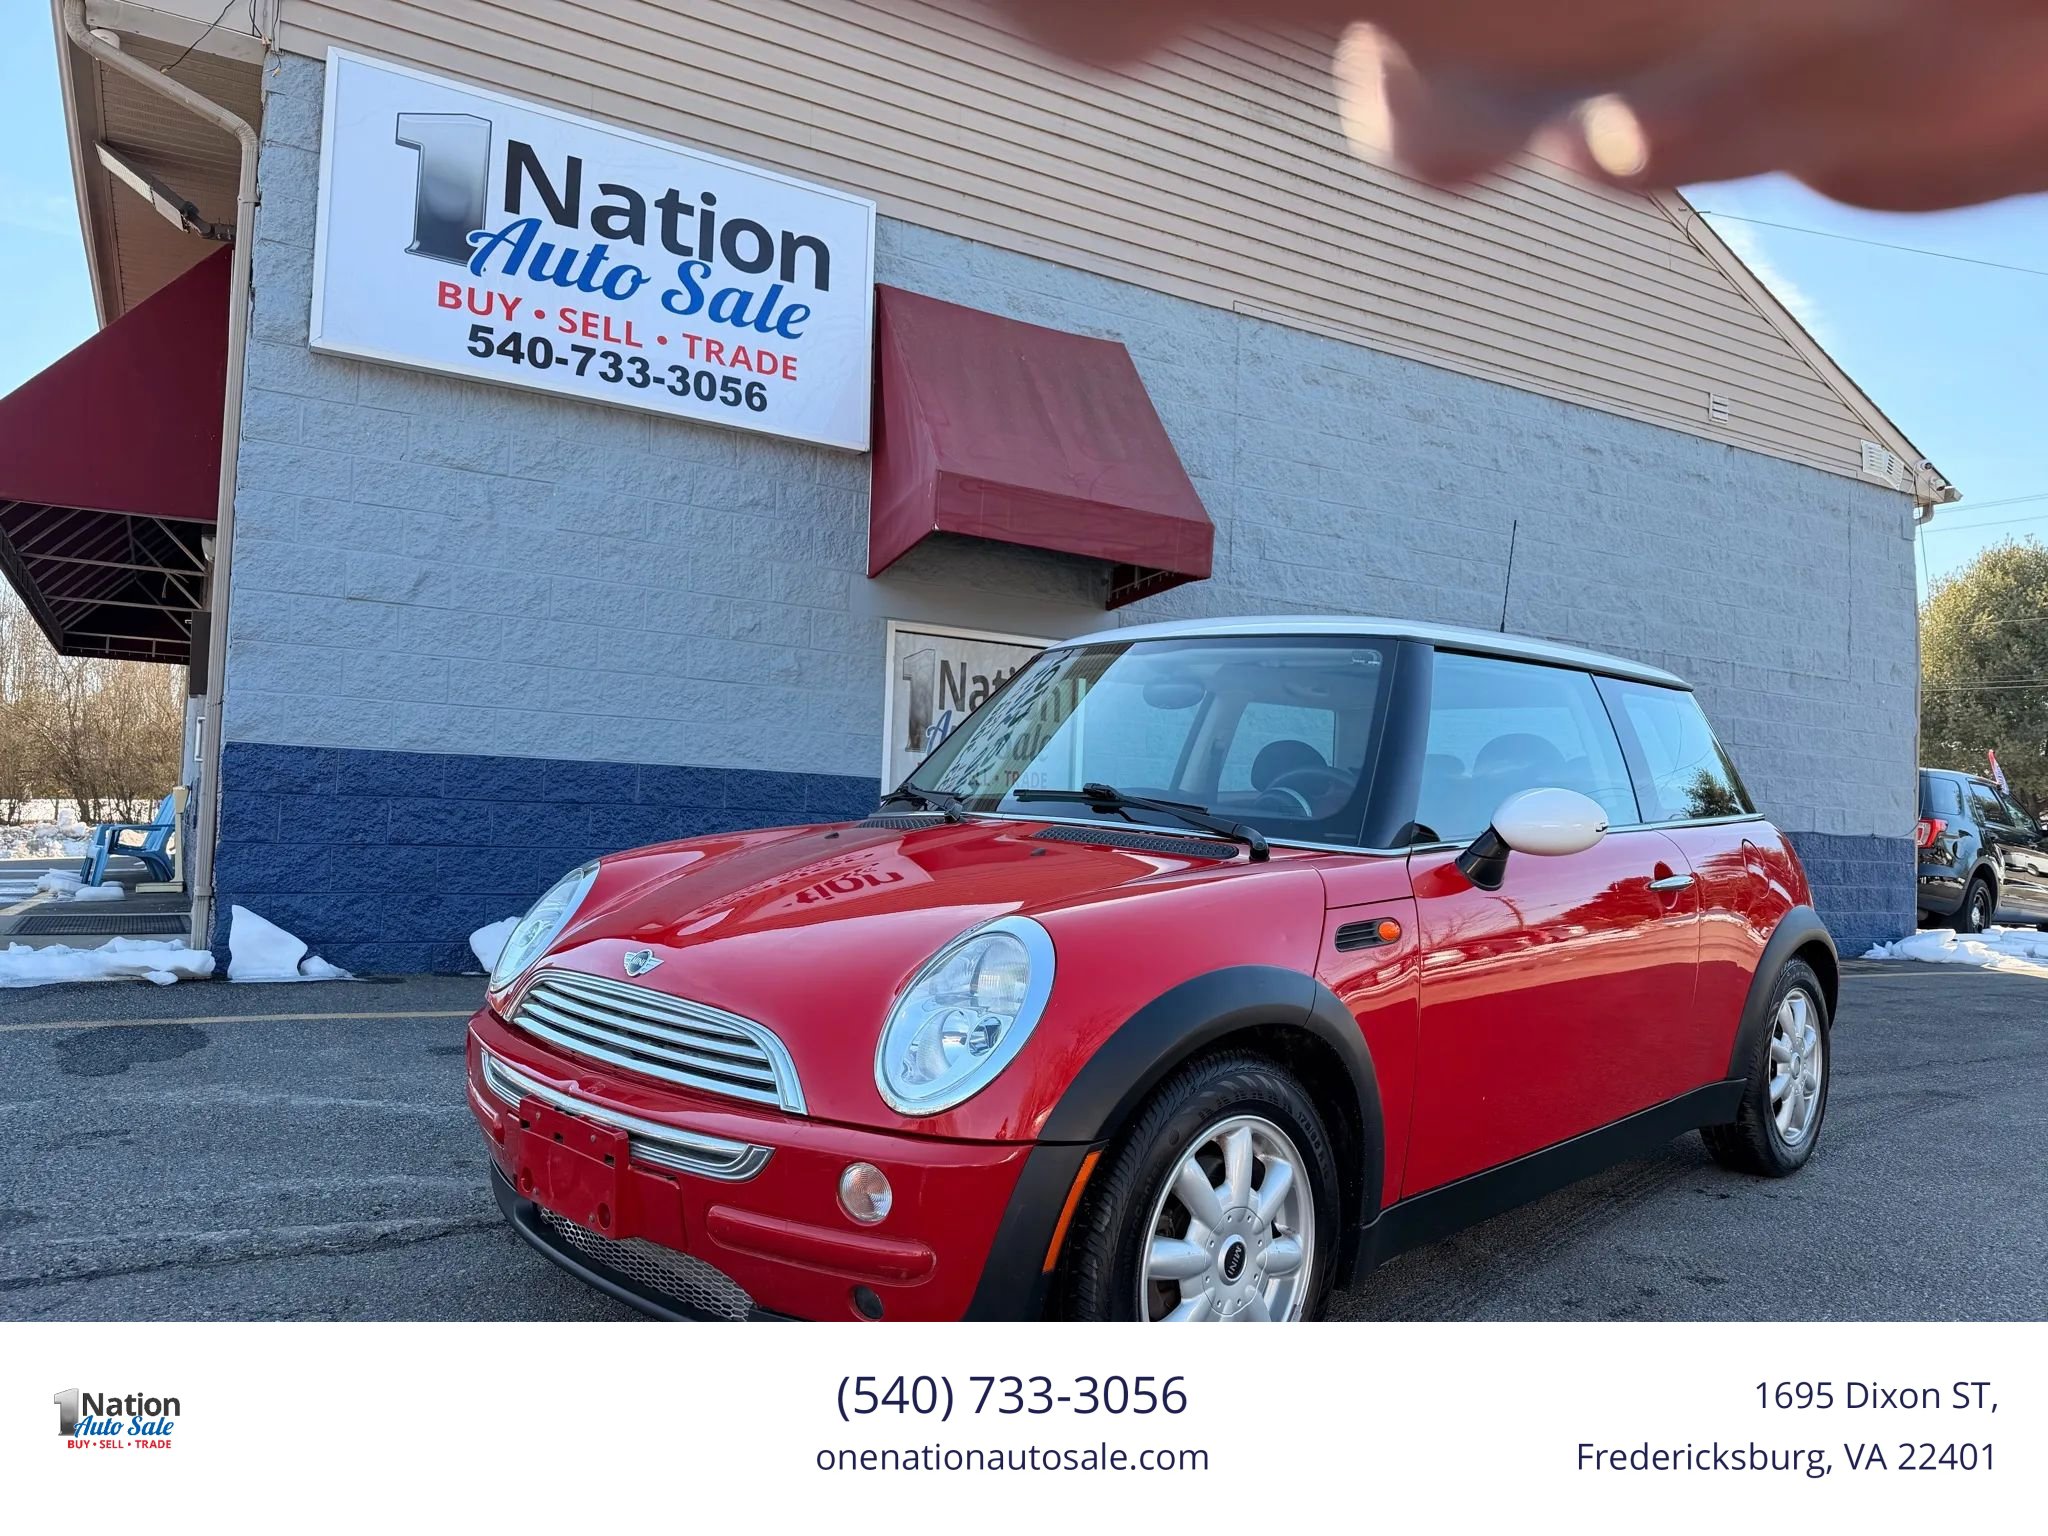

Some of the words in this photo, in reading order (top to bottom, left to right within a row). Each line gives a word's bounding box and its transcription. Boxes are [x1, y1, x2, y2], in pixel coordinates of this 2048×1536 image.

[396, 112, 493, 268] 1
[504, 139, 830, 292] Nation
[468, 217, 652, 301] Auto
[661, 260, 811, 340] Sale
[437, 280, 523, 322] BUY
[558, 307, 644, 349] SELL
[682, 332, 798, 382] TRADE
[467, 323, 768, 413] 540-733-3056
[1227, 1244, 1242, 1276] MINI
